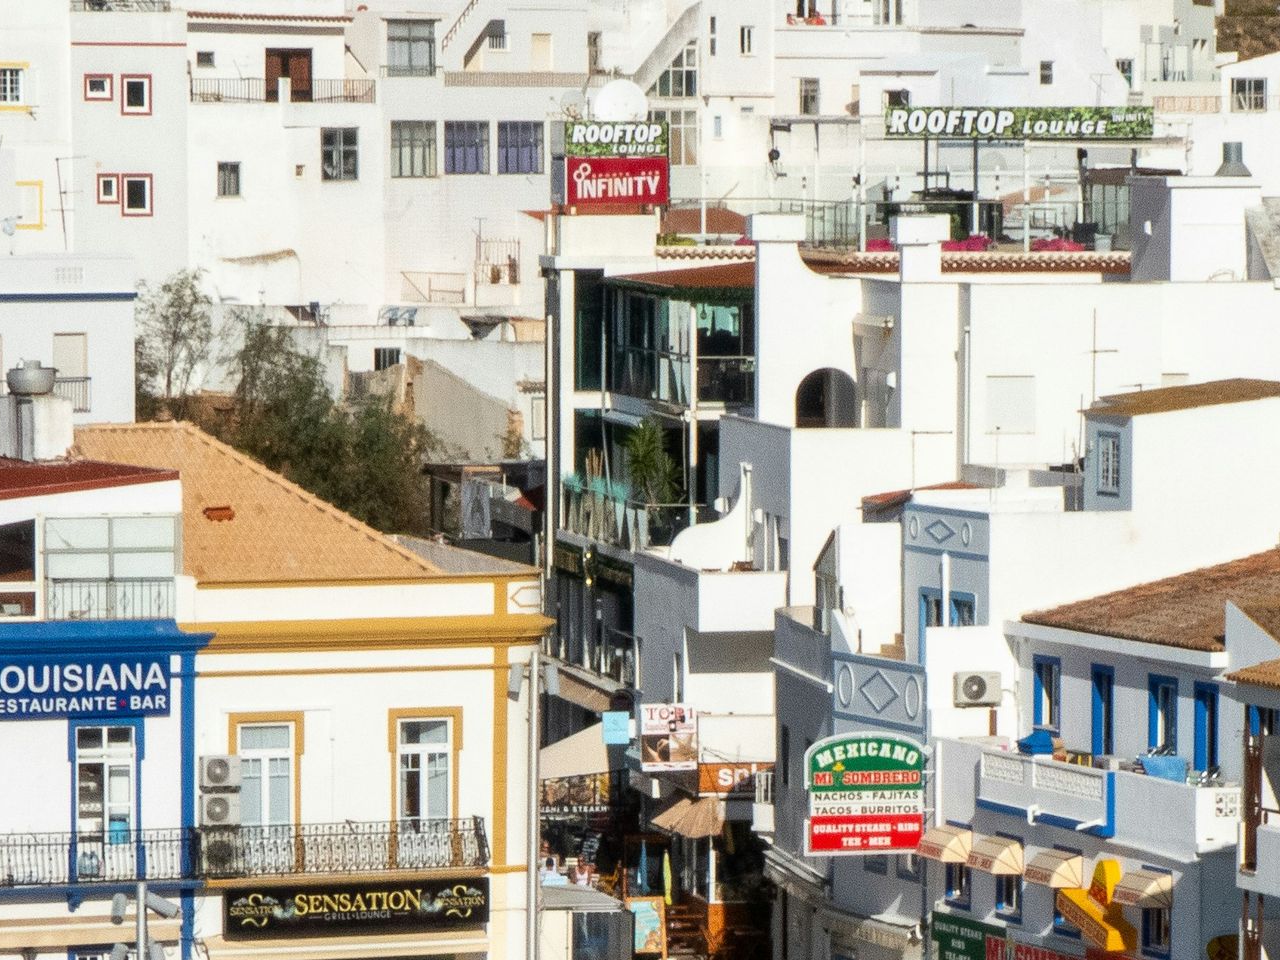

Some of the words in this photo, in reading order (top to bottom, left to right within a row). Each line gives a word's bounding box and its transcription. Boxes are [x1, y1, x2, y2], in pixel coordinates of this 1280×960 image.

[889, 109, 1015, 134] ROOFTOP
[1022, 119, 1107, 134] LOUNGE
[572, 124, 662, 143] ROOFTOP
[612, 143, 662, 153] LOUNGE
[576, 175, 661, 199] INFINITY
[130, 695, 167, 710] BAR
[815, 742, 919, 767] MEXICANO
[814, 772, 833, 785] MI
[842, 770, 921, 785] SOMBRERO
[815, 792, 862, 801] NACHOS
[872, 791, 919, 800] FAJITAS
[815, 806, 852, 815] TACOS
[861, 805, 919, 814] BURRITOS
[813, 823, 854, 834] QUALITY
[293, 888, 422, 917] SENSATION
[324, 911, 352, 921] GRILL
[355, 909, 392, 920] LOUNGE
